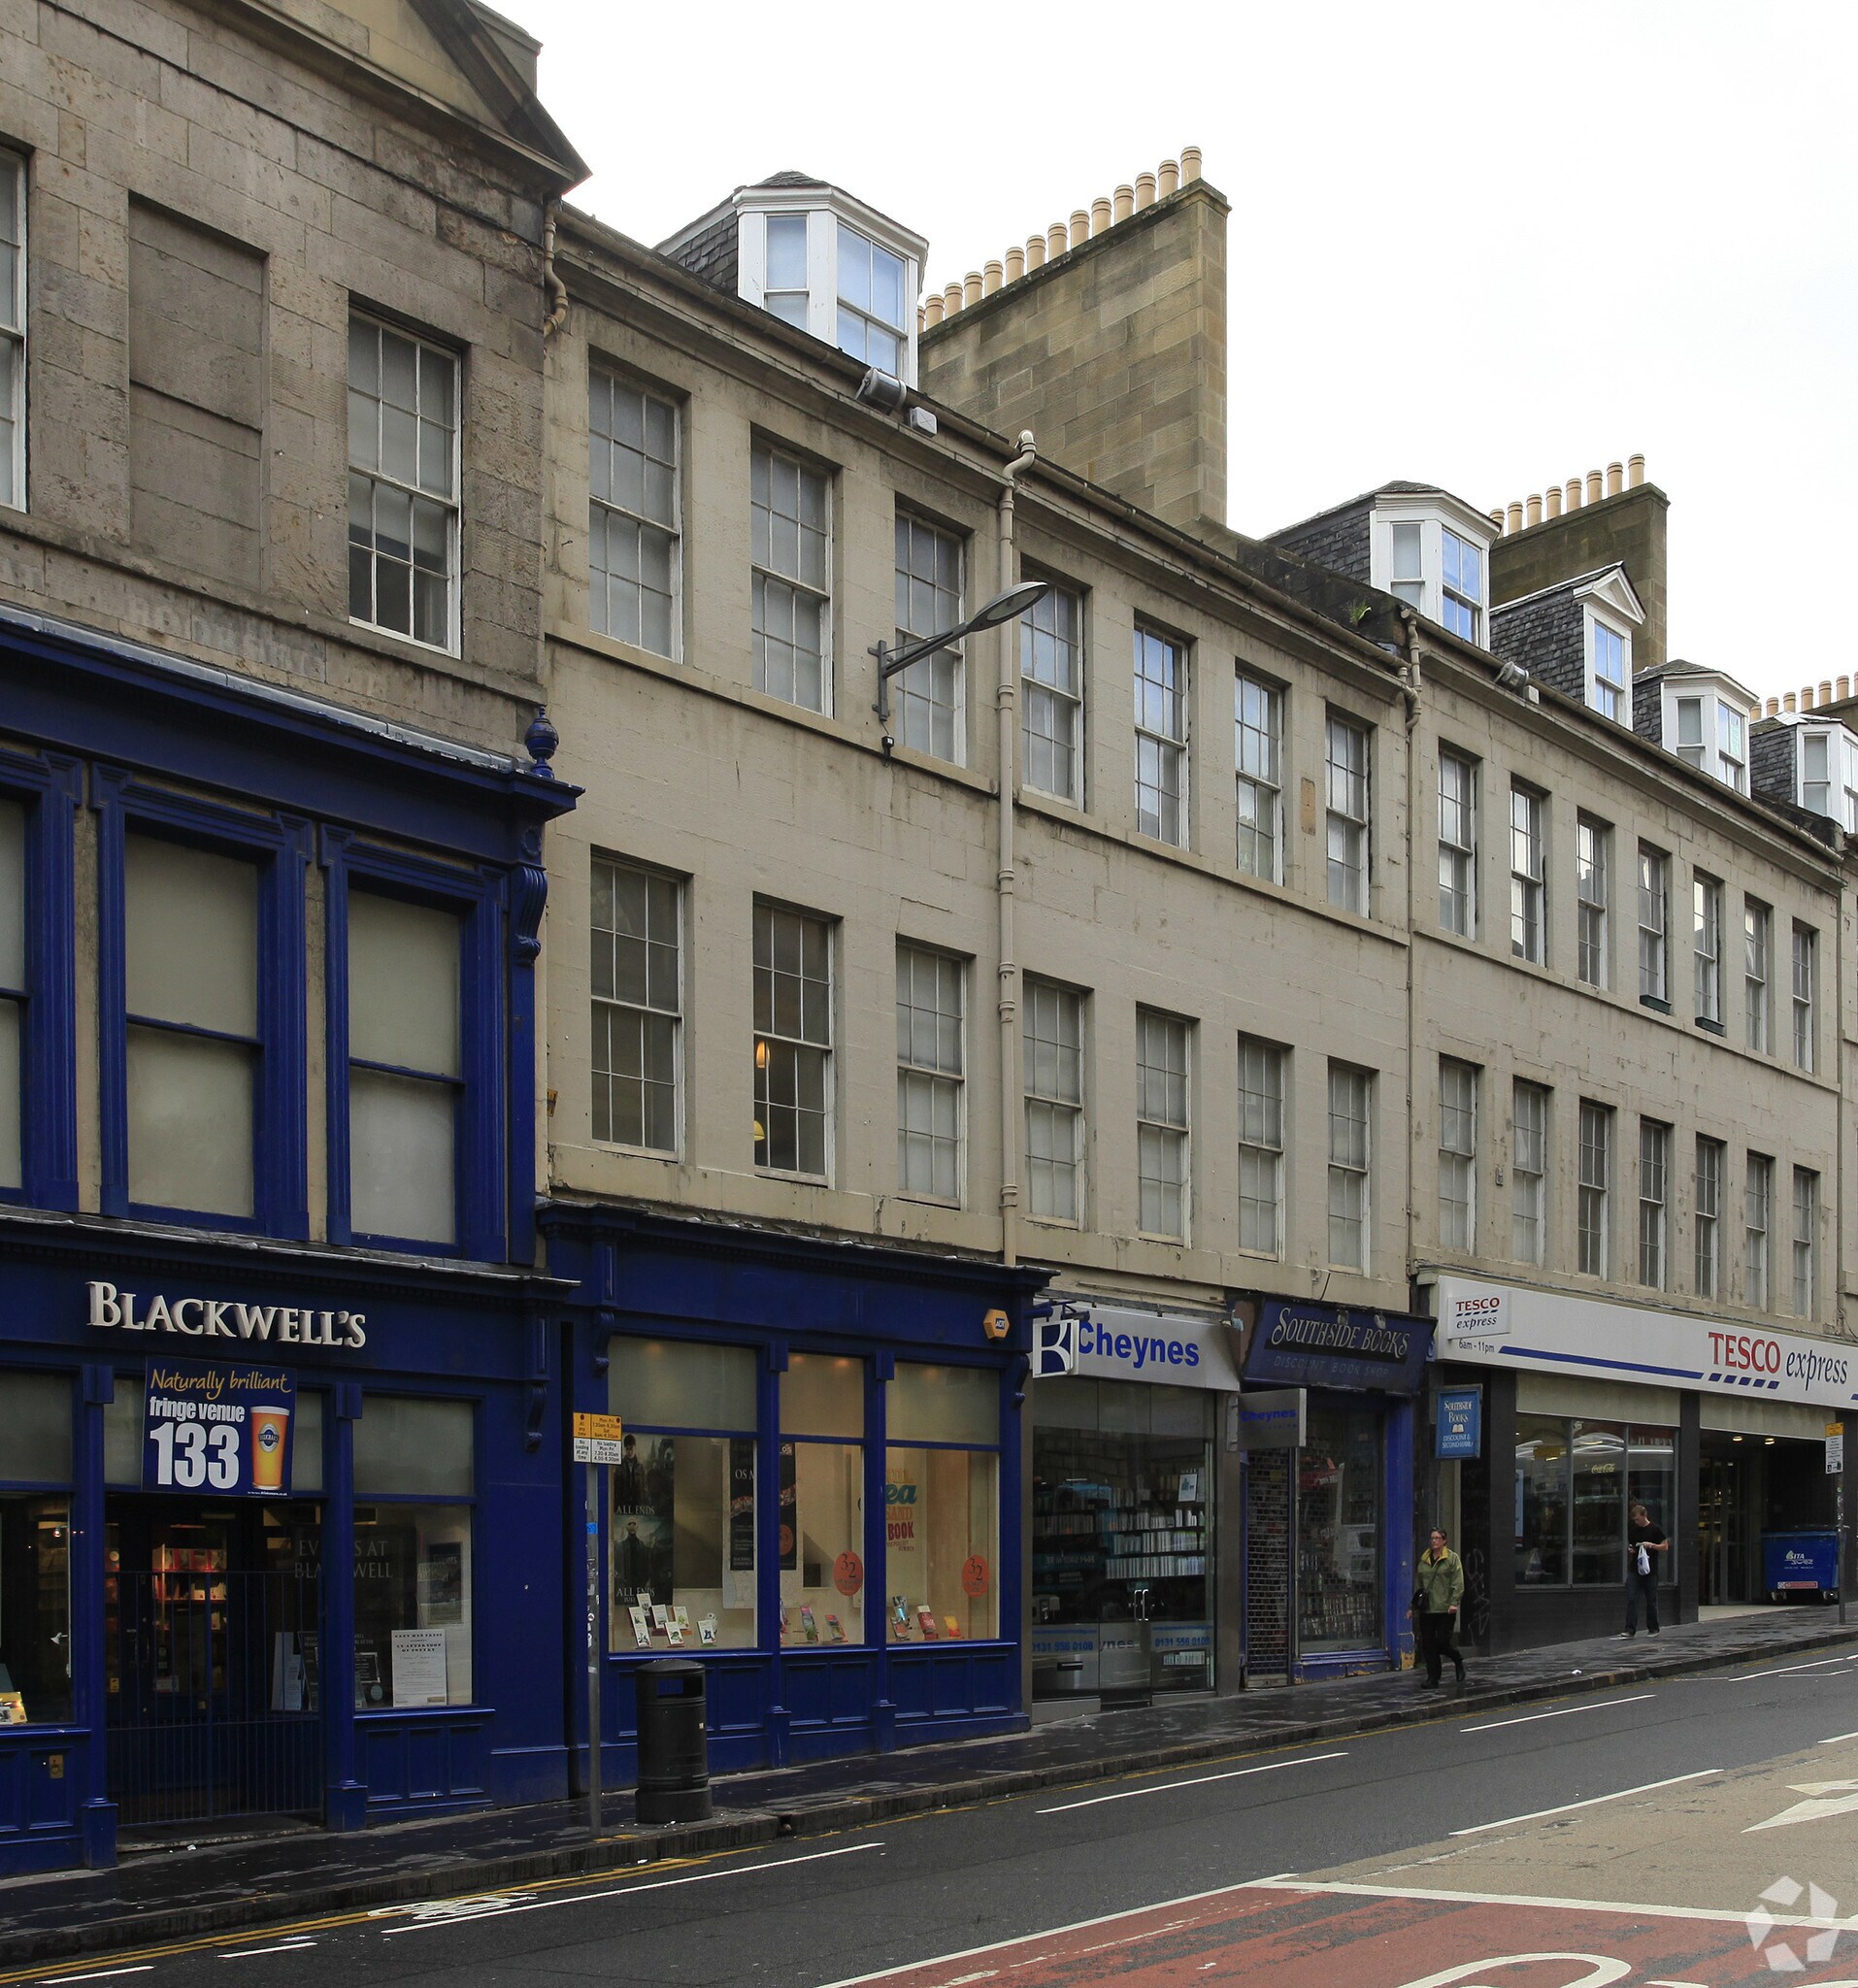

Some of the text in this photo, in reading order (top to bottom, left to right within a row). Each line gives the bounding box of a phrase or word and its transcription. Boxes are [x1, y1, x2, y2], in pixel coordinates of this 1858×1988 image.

[1455, 1297, 1500, 1311] TESCO
[85, 1281, 366, 1348] BLACKWELL'S
[1456, 1316, 1498, 1331] express
[1271, 1308, 1410, 1359] SOUTHSIDE BOOKS
[1078, 1320, 1200, 1369] Cheynes
[1458, 1340, 1473, 1350] 6am
[1477, 1341, 1495, 1354] 11pm
[1708, 1331, 1848, 1391] TESCO express
[1365, 1366, 1390, 1377] SHOP
[149, 1369, 291, 1400] Naturally brilliant
[149, 1396, 246, 1422] fringe venue
[1240, 1408, 1297, 1423] Cheynes
[149, 1421, 240, 1489] 133
[885, 1484, 917, 1505] ea
[616, 1506, 655, 1514] ALL ENDS
[887, 1521, 914, 1541] BOOK
[367, 1540, 388, 1557] AT
[616, 1588, 634, 1597] ALL
[1099, 1640, 1134, 1652] ynes
[1155, 1639, 1174, 1647] 0131
